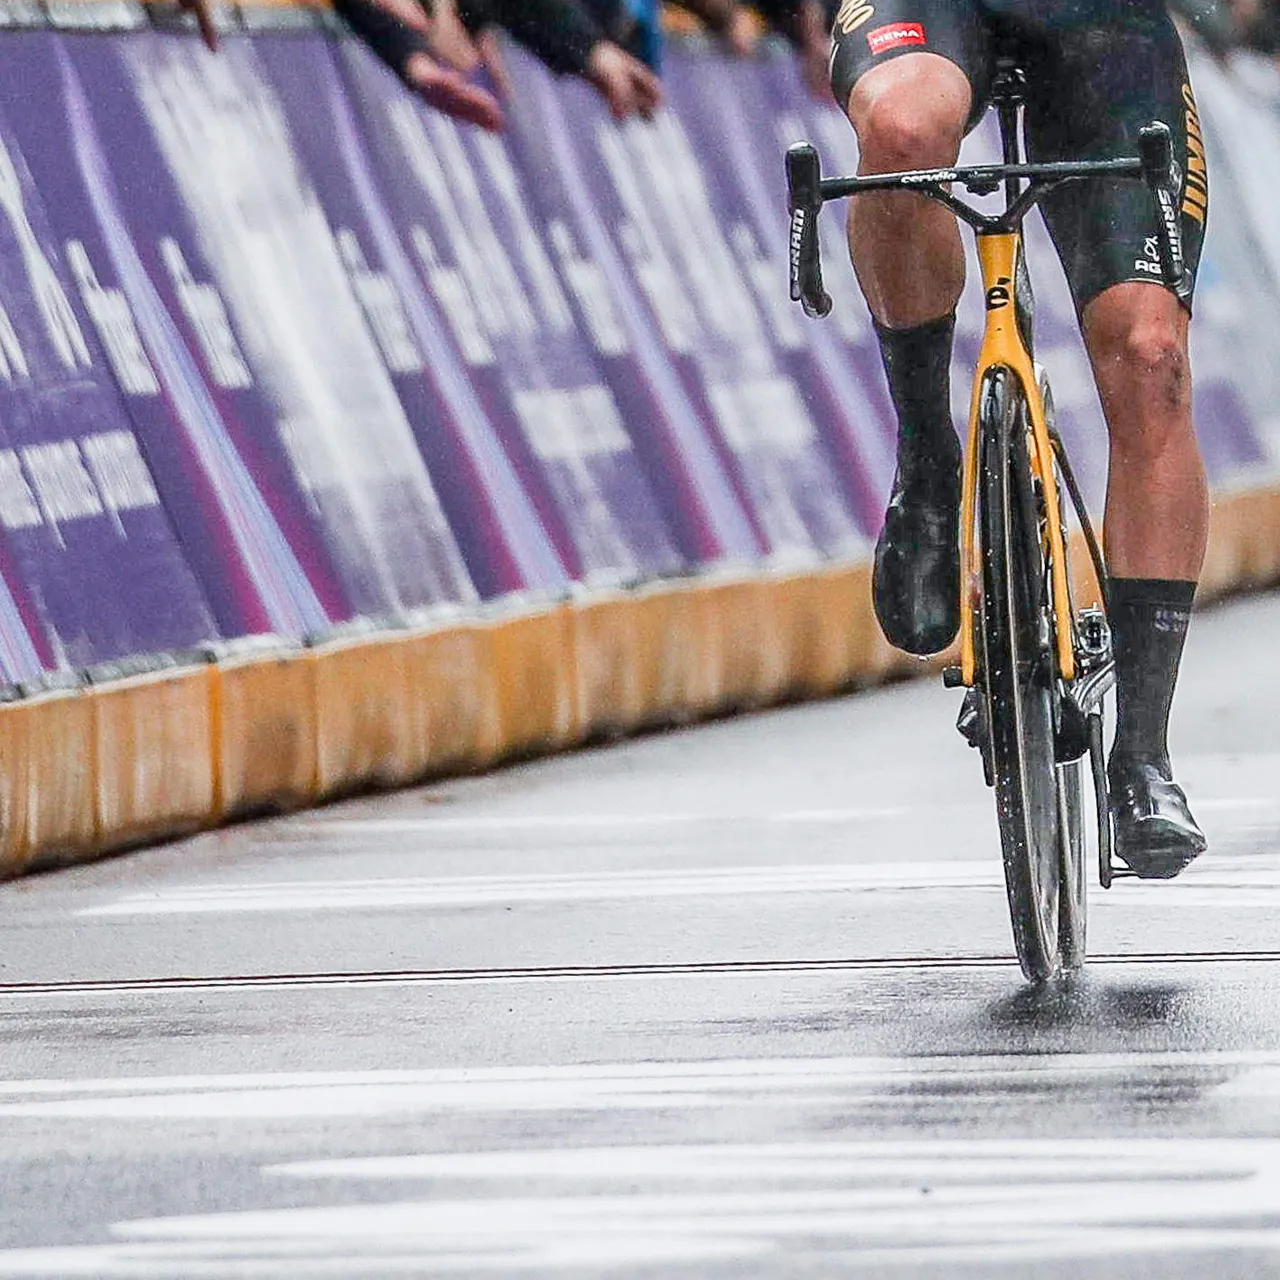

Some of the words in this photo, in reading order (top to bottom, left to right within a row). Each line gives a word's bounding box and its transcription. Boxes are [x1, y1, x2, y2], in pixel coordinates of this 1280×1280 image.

[872, 28, 920, 45] HEMA
[1157, 189, 1184, 262] SRAM
[1134, 260, 1162, 275] AG
